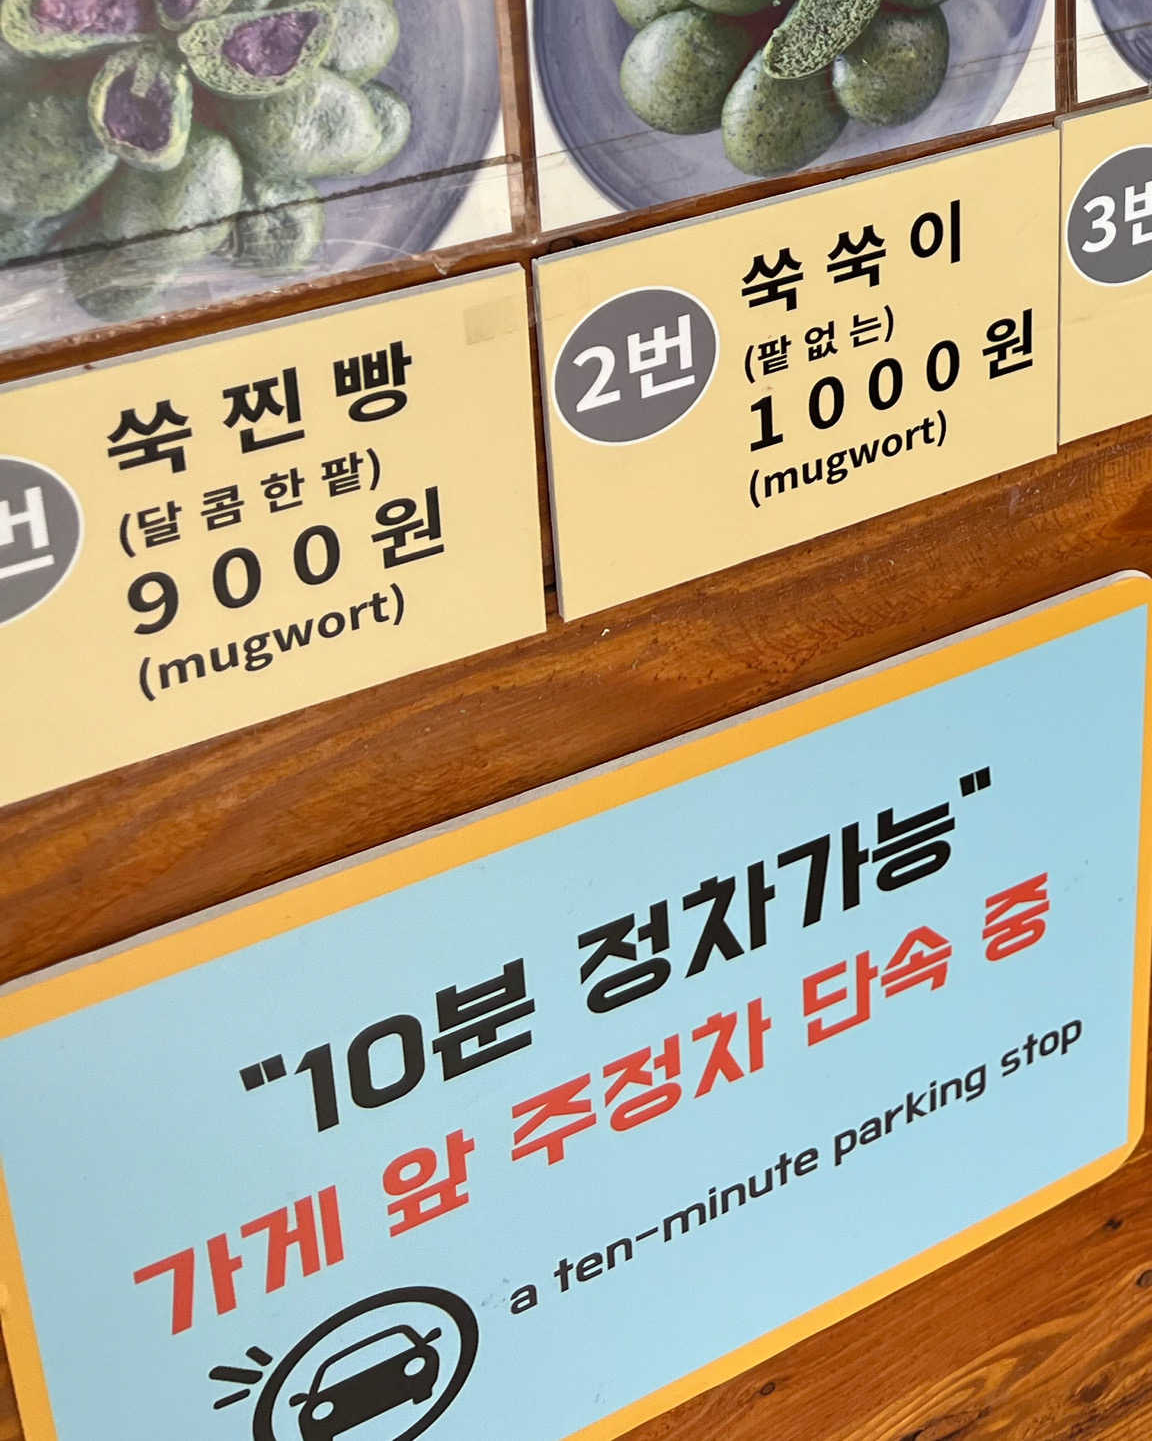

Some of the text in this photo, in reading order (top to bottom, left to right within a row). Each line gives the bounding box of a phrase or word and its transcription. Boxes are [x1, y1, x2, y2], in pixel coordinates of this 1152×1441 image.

[572, 313, 697, 413] 2번
[748, 409, 947, 509] (mugwort)
[0, 486, 55, 579] 번
[139, 583, 405, 702] (mugwort)
[132, 872, 1051, 1336] 가게 앞 주정차 단속 중
[239, 957, 536, 1133] "10분
[510, 1019, 1083, 1316] a ten-minute parking stop
